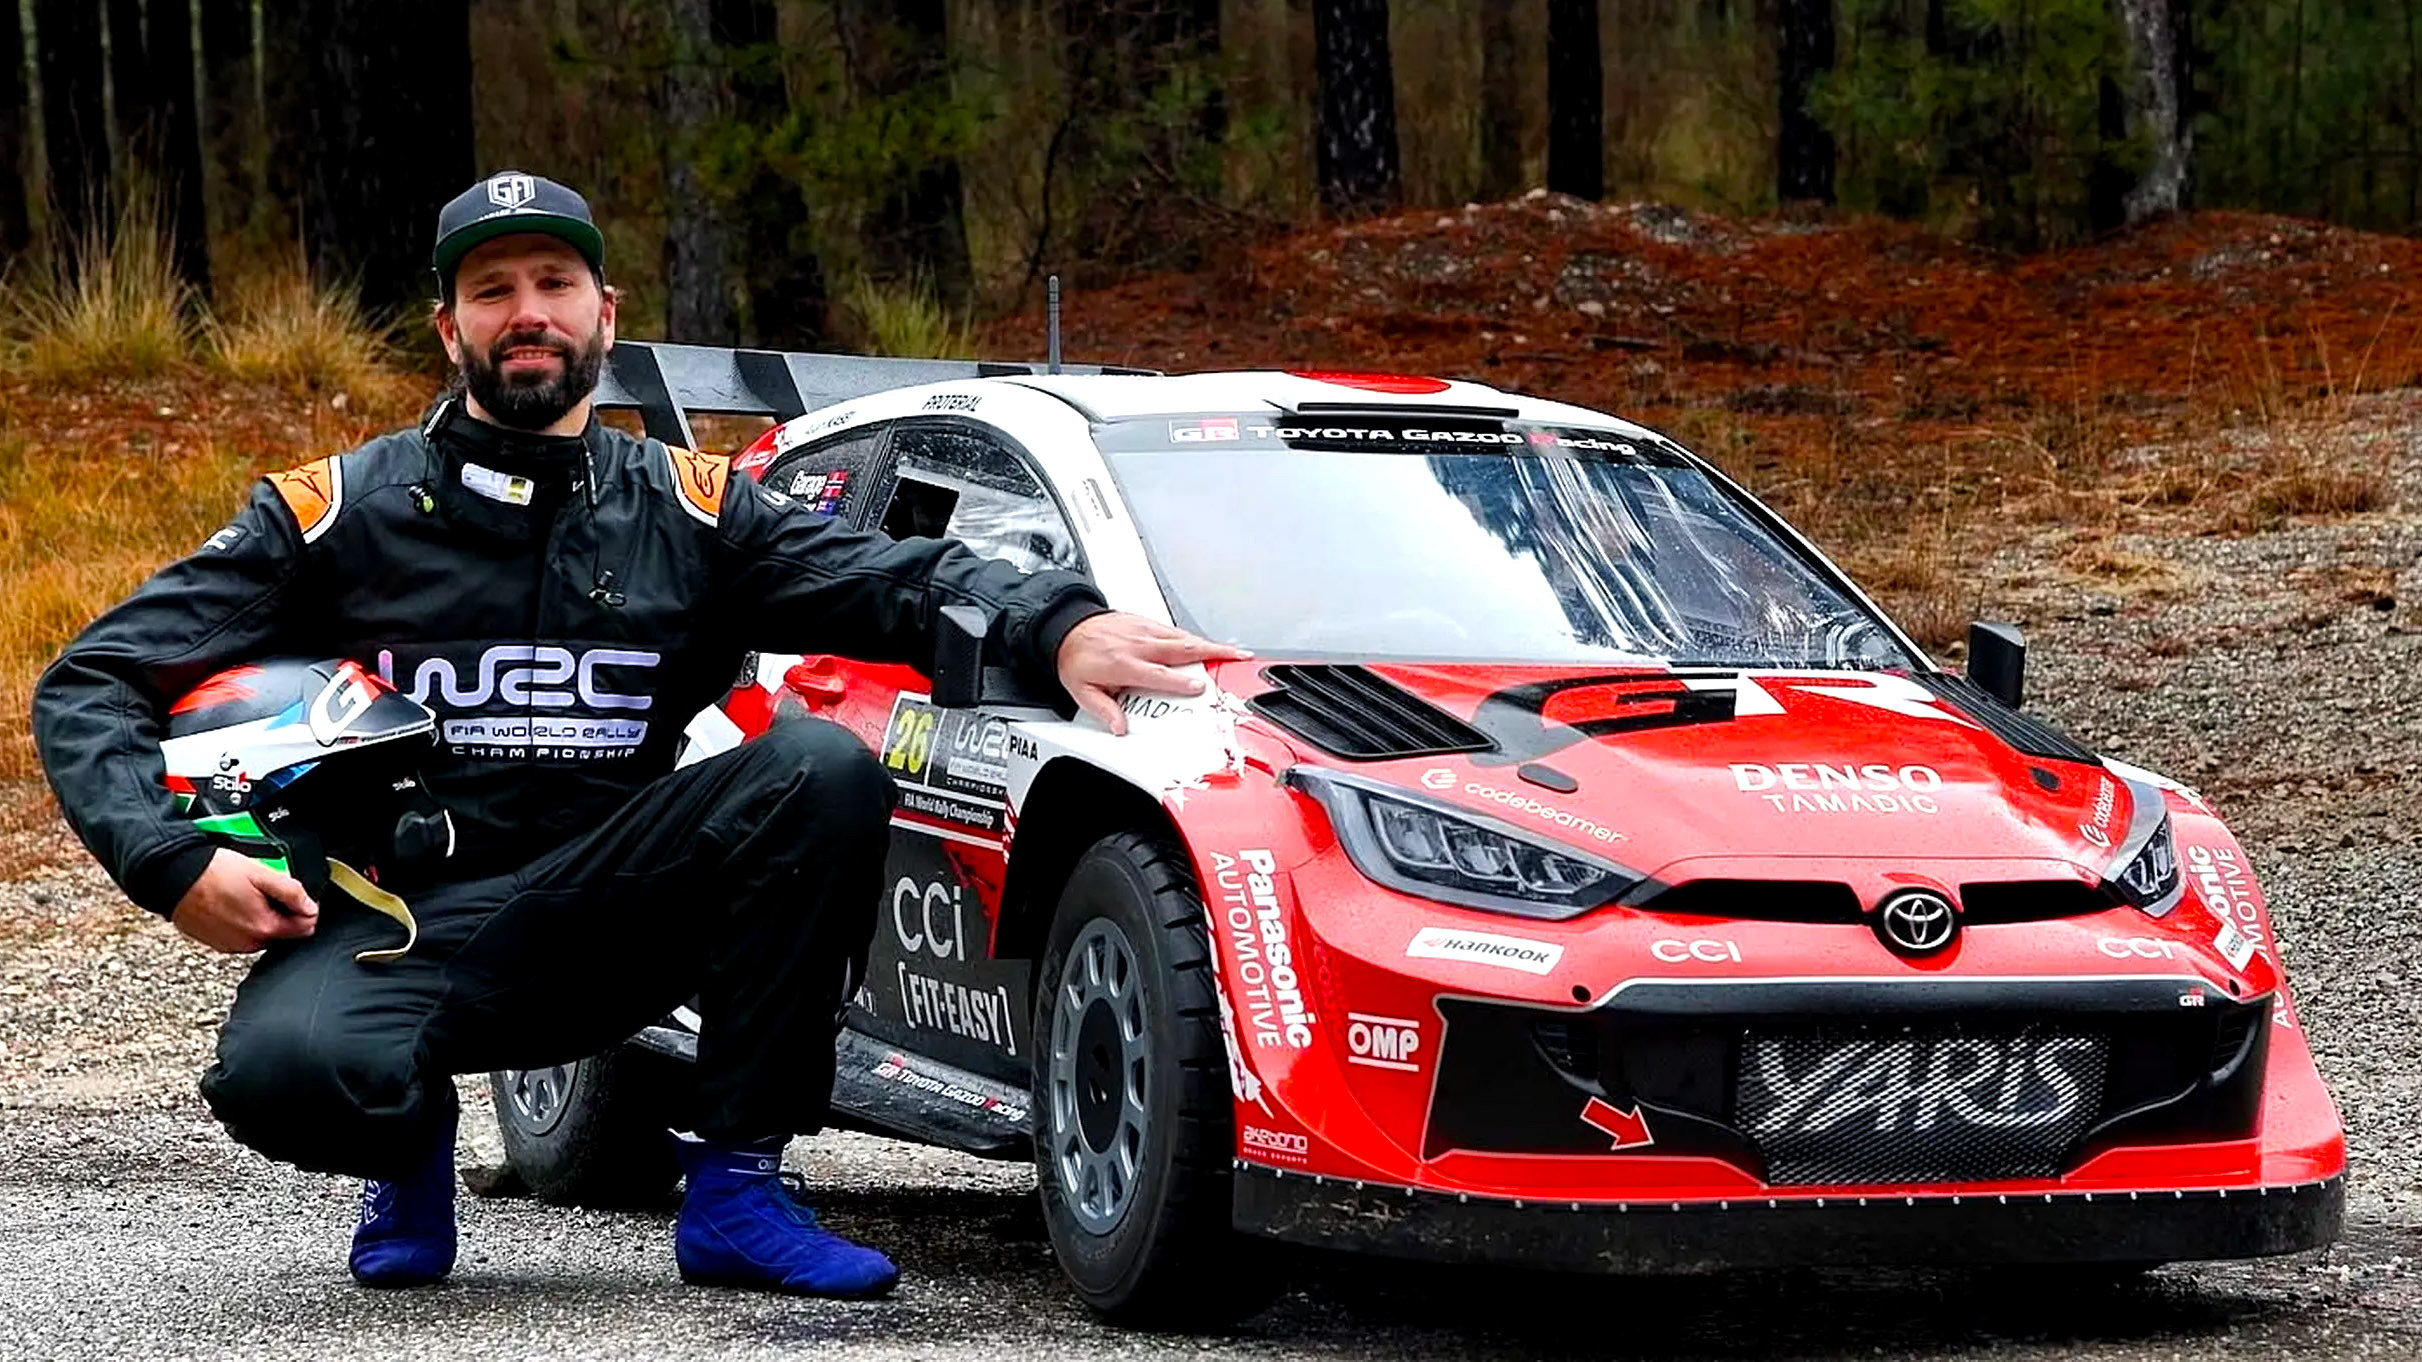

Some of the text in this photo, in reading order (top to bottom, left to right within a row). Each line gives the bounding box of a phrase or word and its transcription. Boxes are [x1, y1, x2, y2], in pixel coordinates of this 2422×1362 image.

[1174, 426, 1240, 442] GR
[1246, 426, 1394, 441] TOYOTA
[1401, 429, 1524, 444] GAZOO
[377, 645, 661, 711] WRC
[451, 725, 642, 739] FIA WORLD RALLY
[1468, 663, 1984, 768] GR
[451, 746, 636, 760] CHAMPIONSHIP
[888, 708, 933, 774] 26
[1009, 734, 1039, 762] PIAA
[213, 772, 251, 792] Stilo
[1728, 763, 1943, 792] DENSO
[1464, 780, 1625, 844] codebeamer
[1762, 793, 1939, 815] TAMADIC
[1210, 852, 1283, 1049] AUTOMOTIVE
[1239, 848, 1313, 1049] Panasonic
[2179, 995, 2205, 1007] GR
[1348, 1023, 1420, 1062] OMP
[898, 1069, 943, 1094] TOYOTA
[941, 1084, 986, 1107] GAZOO
